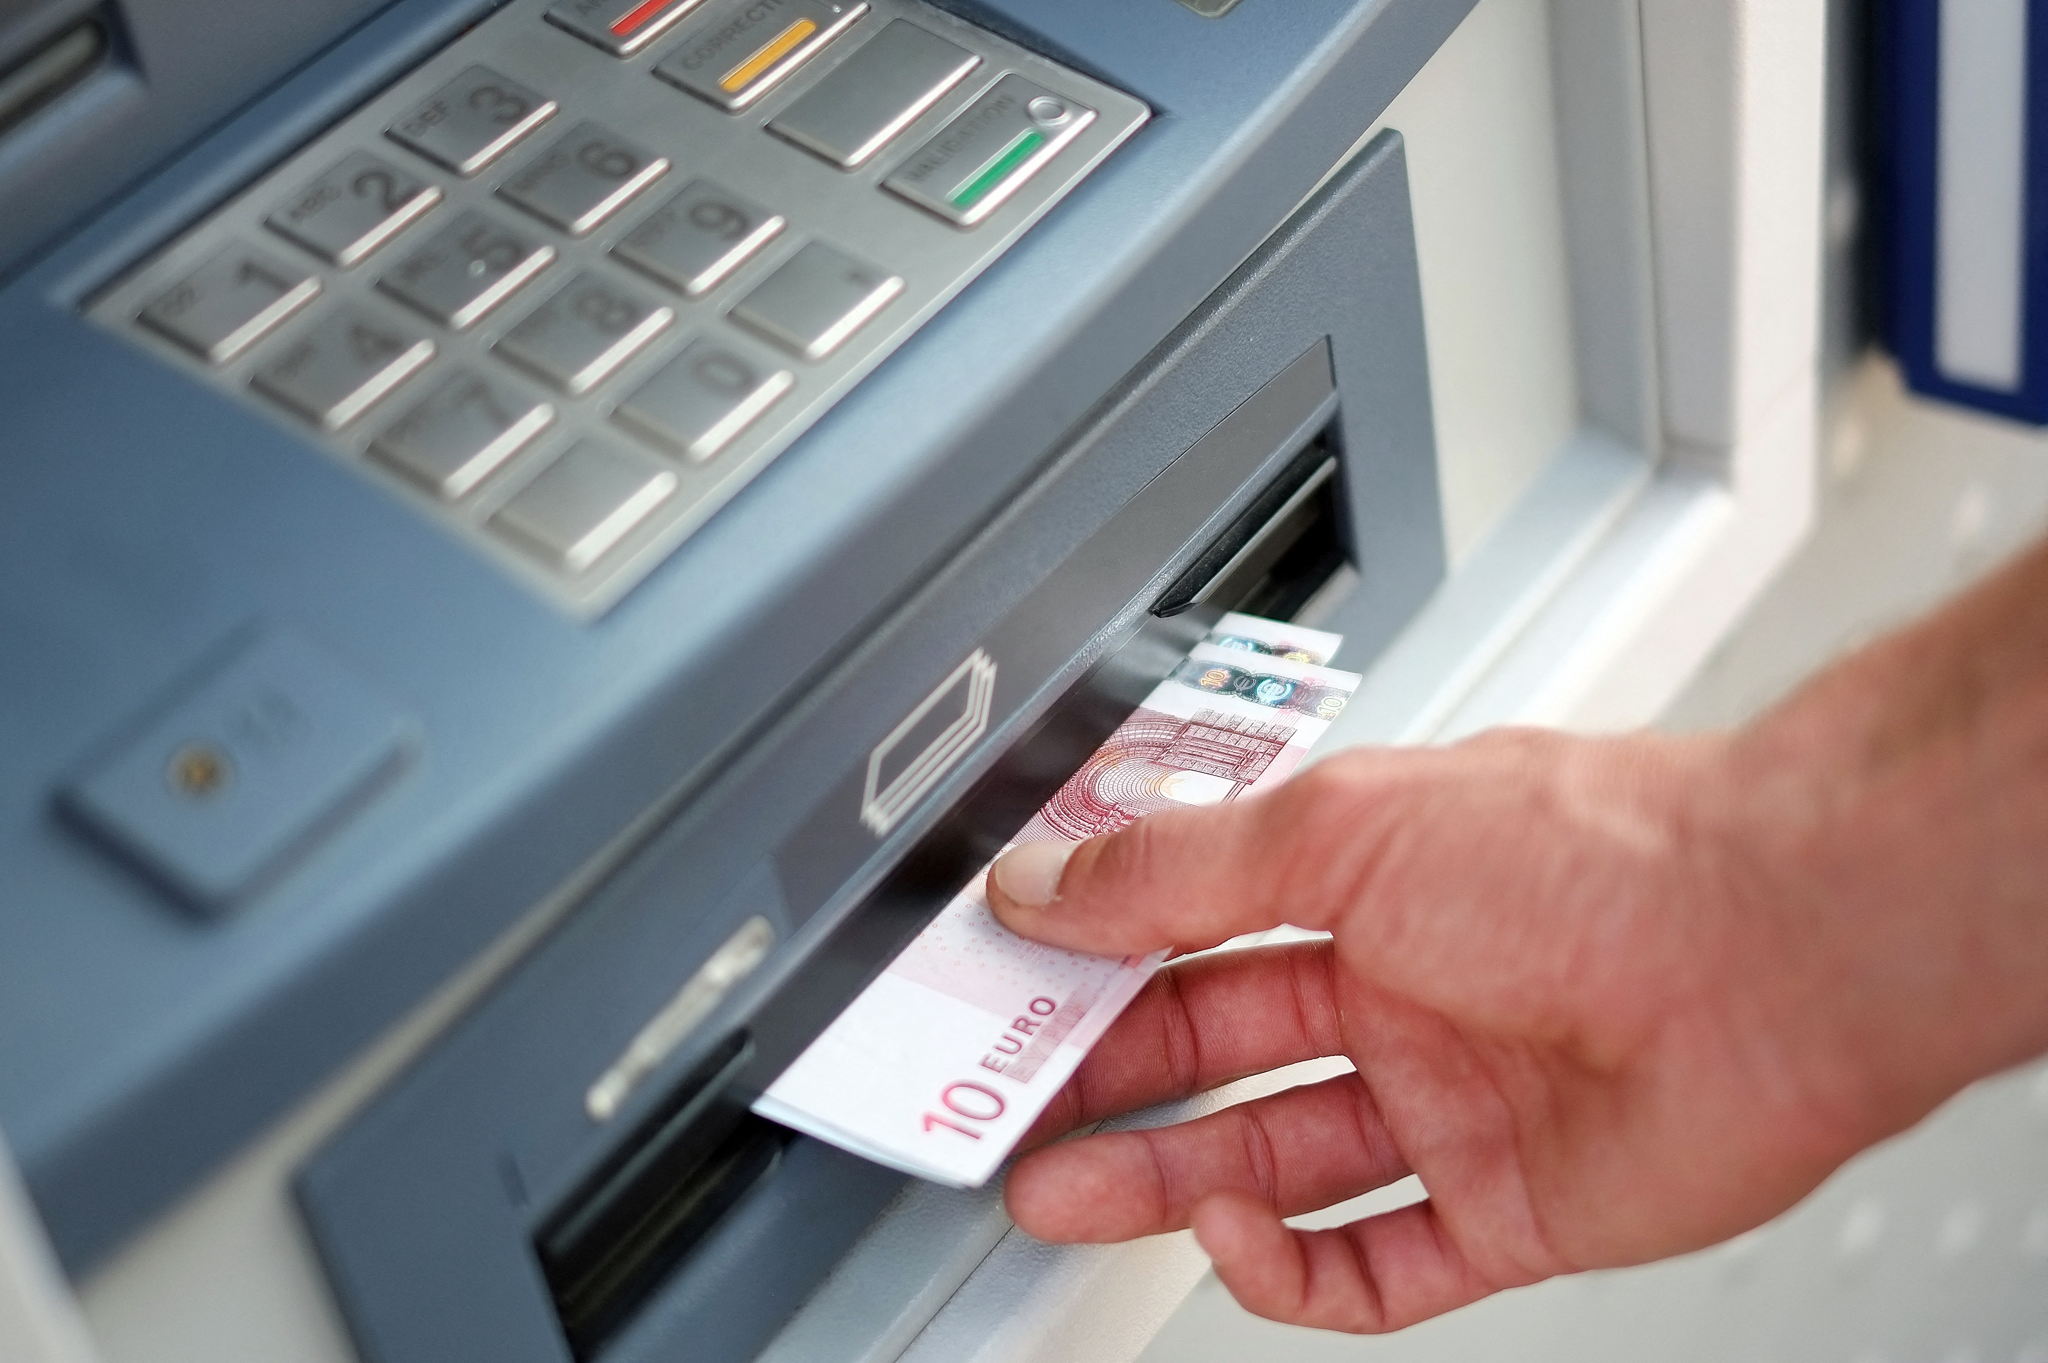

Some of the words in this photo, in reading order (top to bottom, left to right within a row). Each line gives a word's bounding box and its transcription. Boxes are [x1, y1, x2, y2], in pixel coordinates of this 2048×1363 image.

[468, 86, 528, 123] 3
[577, 141, 637, 179] 6
[354, 171, 417, 212] 2
[690, 202, 748, 242] 9
[236, 262, 295, 292] 1
[921, 1080, 1007, 1141] 10
[980, 997, 1056, 1073] EURO
